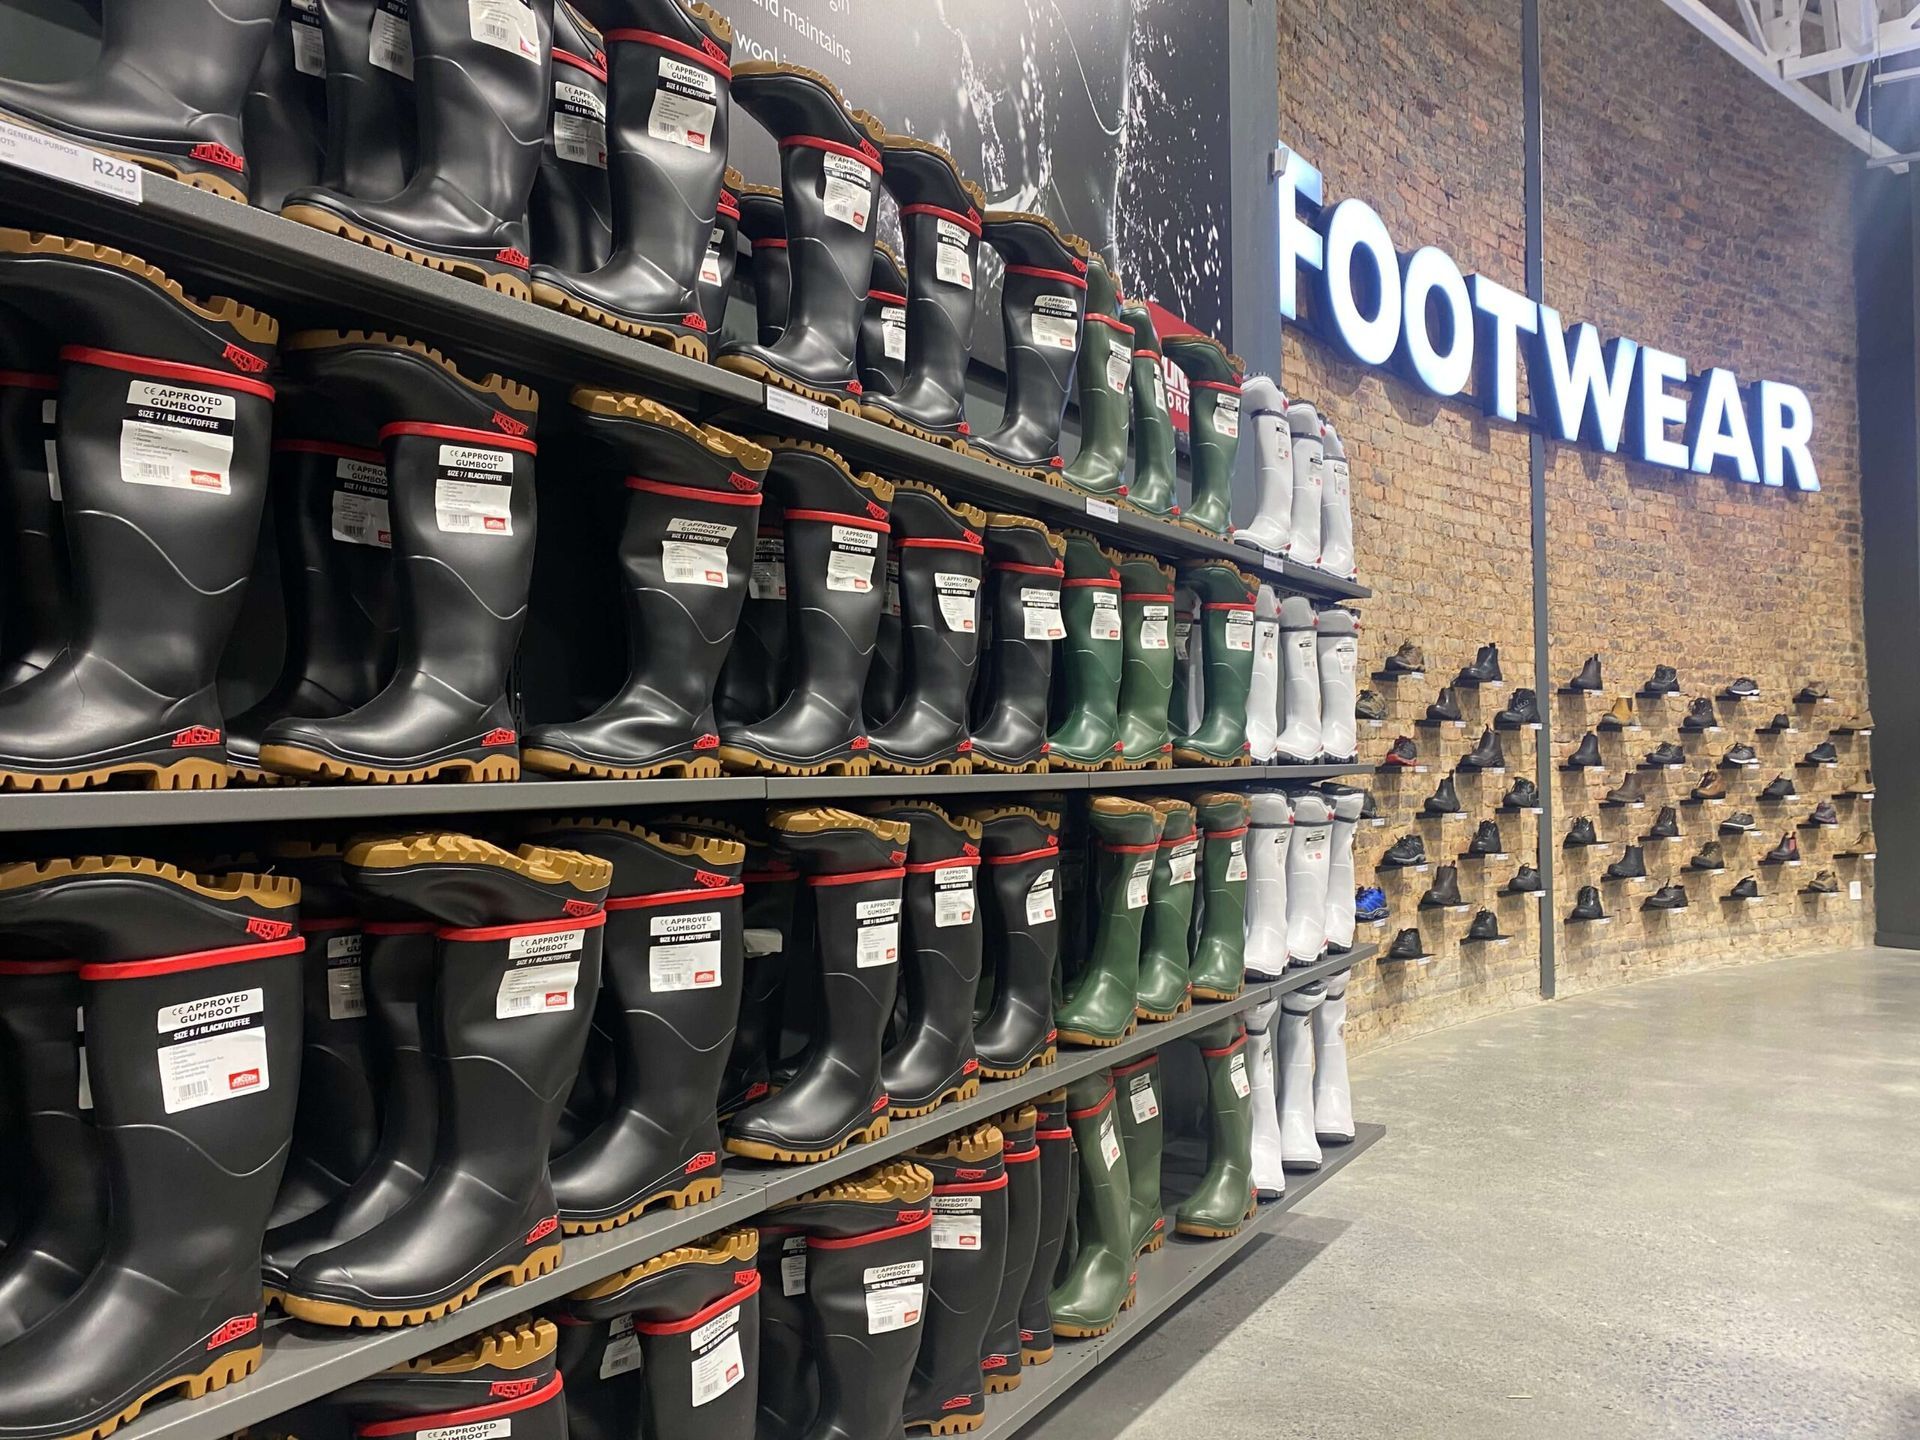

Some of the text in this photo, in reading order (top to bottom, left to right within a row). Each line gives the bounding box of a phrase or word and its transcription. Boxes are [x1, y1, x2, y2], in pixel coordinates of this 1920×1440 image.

[782, 7, 852, 66] maintains
[671, 71, 705, 88] GUMBOOT
[675, 65, 709, 82] APPROVED
[7, 128, 43, 146] GENERAL
[43, 140, 80, 157] PURPOSE
[92, 157, 137, 183] R249
[1278, 141, 1821, 491] FOOTWEAR
[159, 389, 222, 407] APPROVED
[151, 398, 214, 415] GUMBOOT
[811, 405, 828, 419] R249
[138, 409, 220, 430] SIZE 7 / BLACK/TOFFEE
[461, 451, 504, 462] APPROVED
[456, 459, 498, 470] GUMBOOT
[352, 472, 387, 486] GUMBOO
[468, 471, 503, 482] BLACK/TOFFEE
[681, 526, 720, 535] GUMBOOT
[688, 521, 727, 531] APPROVED
[842, 536, 869, 545] GUMBOOT
[846, 530, 872, 540] APPROVED
[670, 915, 712, 925] APPROVED
[666, 923, 707, 932] GUMBOOT
[531, 933, 575, 946] APPROVED
[526, 942, 568, 955] GUMBOOT
[186, 993, 249, 1014] APPROVED
[180, 1004, 241, 1024] GUMBOOT
[173, 1030, 189, 1041] SIZE
[200, 1016, 251, 1035] BLACK/TOFFEE
[877, 1270, 911, 1280] GUMBOOT
[880, 1263, 916, 1273] APPROVED
[489, 1378, 538, 1399] JONSSON
[440, 1422, 497, 1438] APPROVED
